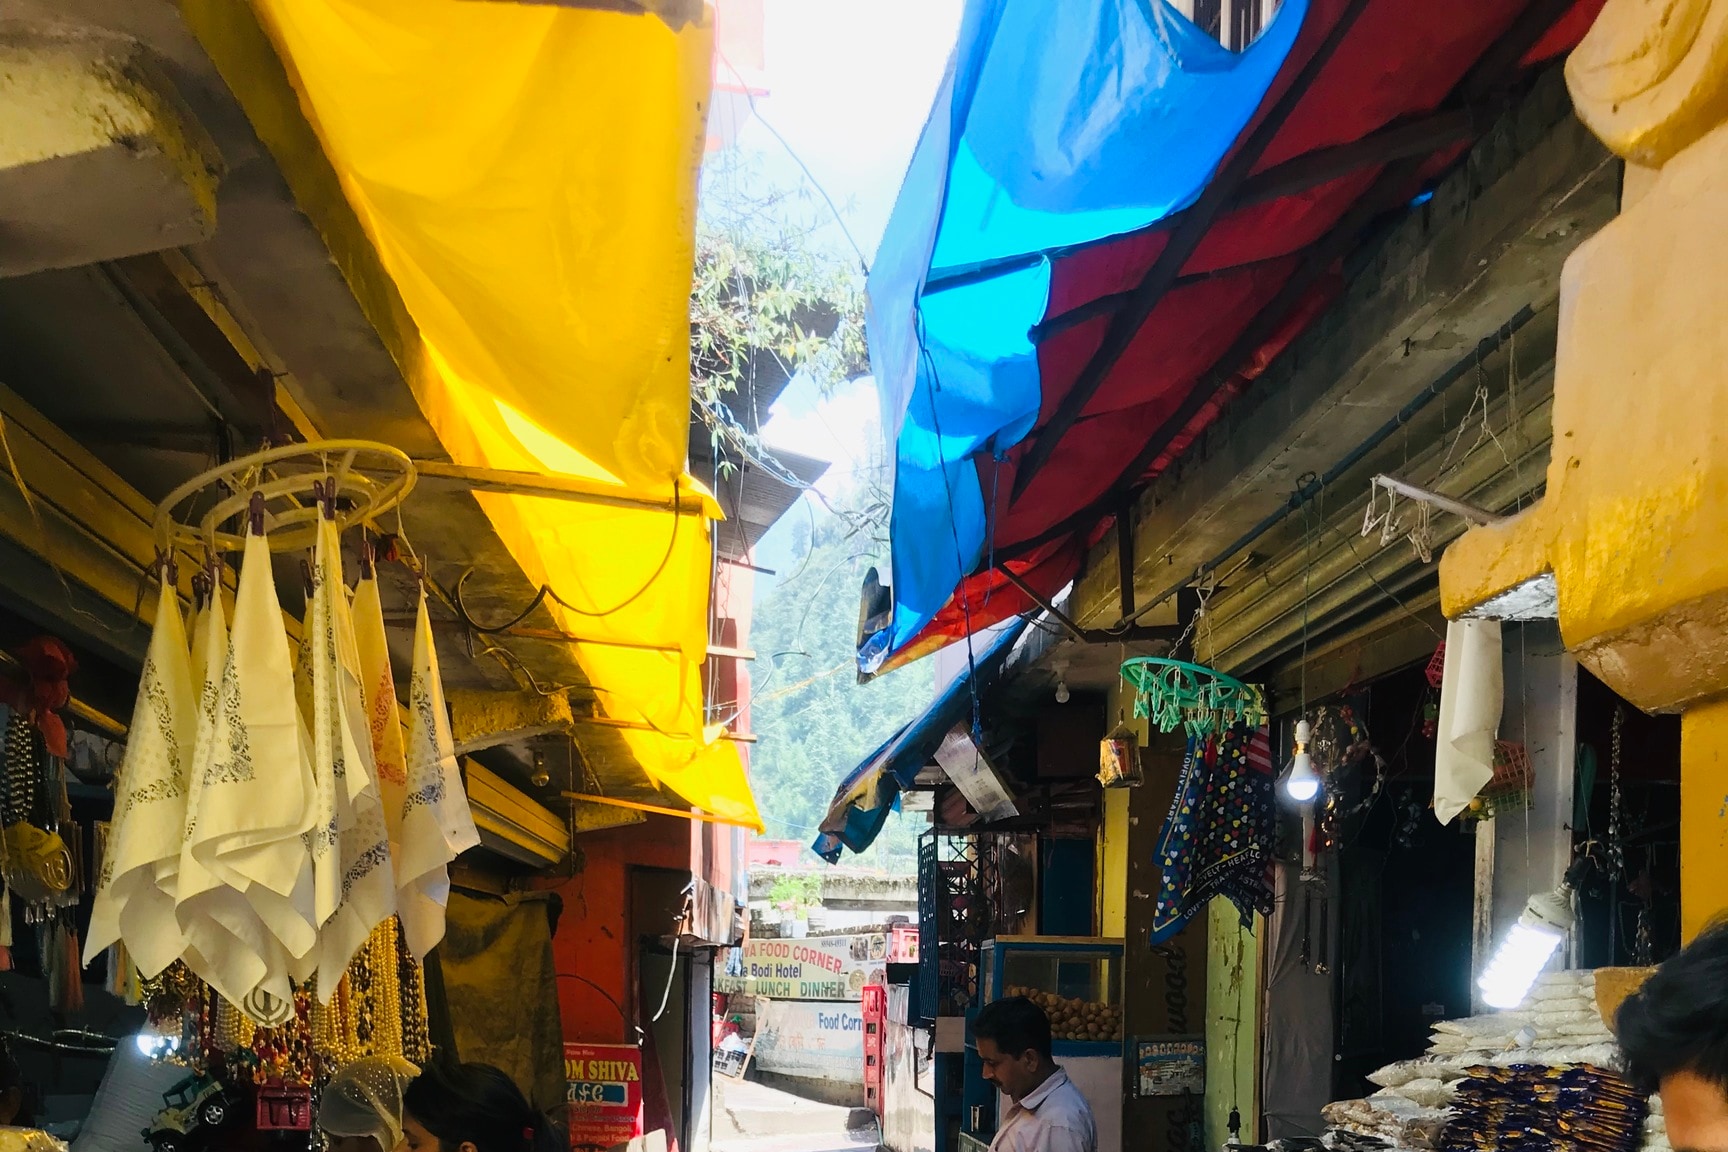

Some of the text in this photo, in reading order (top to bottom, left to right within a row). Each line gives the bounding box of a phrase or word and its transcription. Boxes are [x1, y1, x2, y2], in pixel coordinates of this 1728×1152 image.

[759, 942, 790, 959] FOOD
[792, 945, 843, 976] CORNER
[751, 963, 773, 978] Bodi
[775, 962, 802, 979] Hotel
[714, 978, 846, 998] AKFAST LUNCH DINNER
[818, 1012, 839, 1030] Food
[588, 1059, 640, 1081] SHIVA
